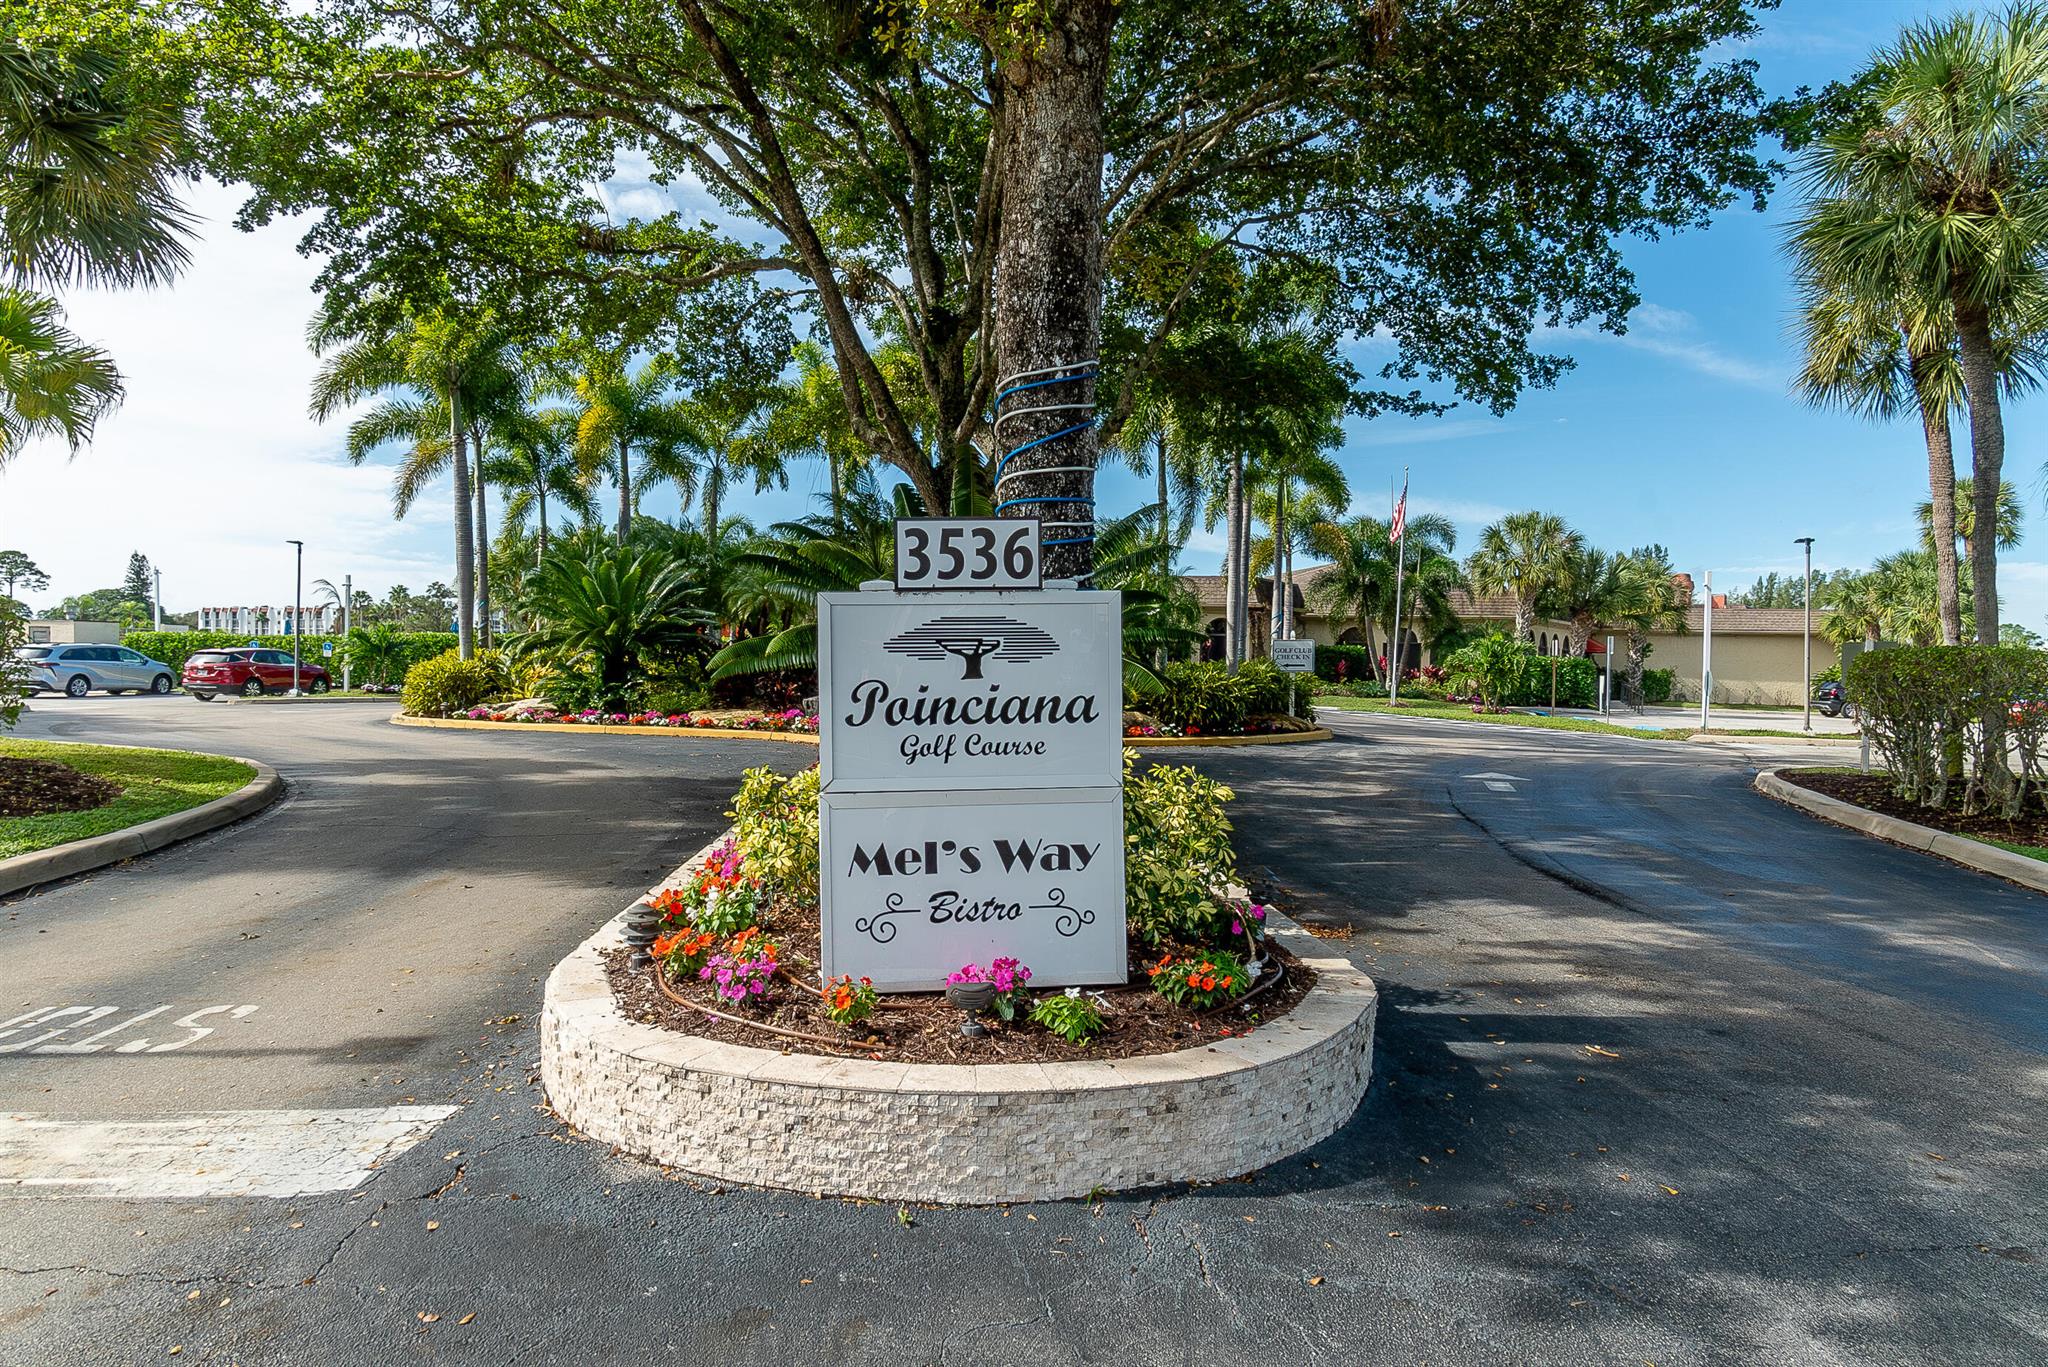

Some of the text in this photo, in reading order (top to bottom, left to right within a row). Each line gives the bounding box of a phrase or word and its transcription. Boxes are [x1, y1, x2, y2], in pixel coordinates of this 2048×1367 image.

[904, 527, 1033, 581] 3536
[845, 679, 1100, 728] Poinciana
[900, 733, 1046, 765] Golf Course
[848, 839, 1101, 878] Mel's Way
[928, 890, 1023, 924] Bistro
[0, 1005, 260, 1053] STO
